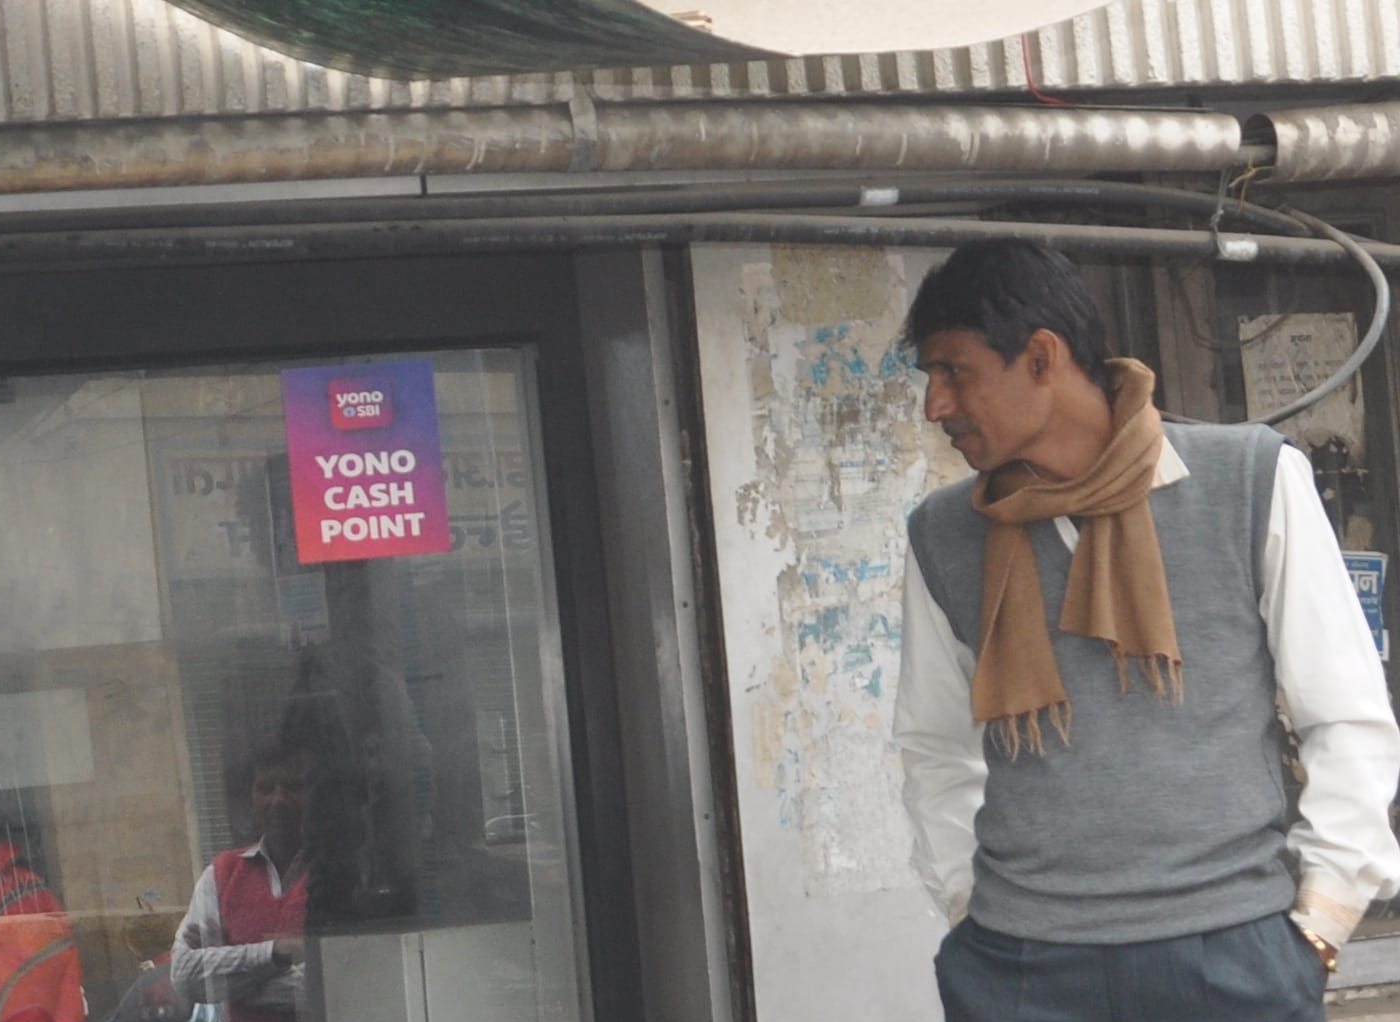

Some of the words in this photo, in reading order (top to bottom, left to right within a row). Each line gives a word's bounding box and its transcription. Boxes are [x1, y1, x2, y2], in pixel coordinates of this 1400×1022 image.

[336, 391, 384, 407] yono
[357, 404, 381, 417] SBI
[315, 449, 417, 479] YONO
[323, 480, 415, 511] CASH
[320, 512, 425, 544] POINT
